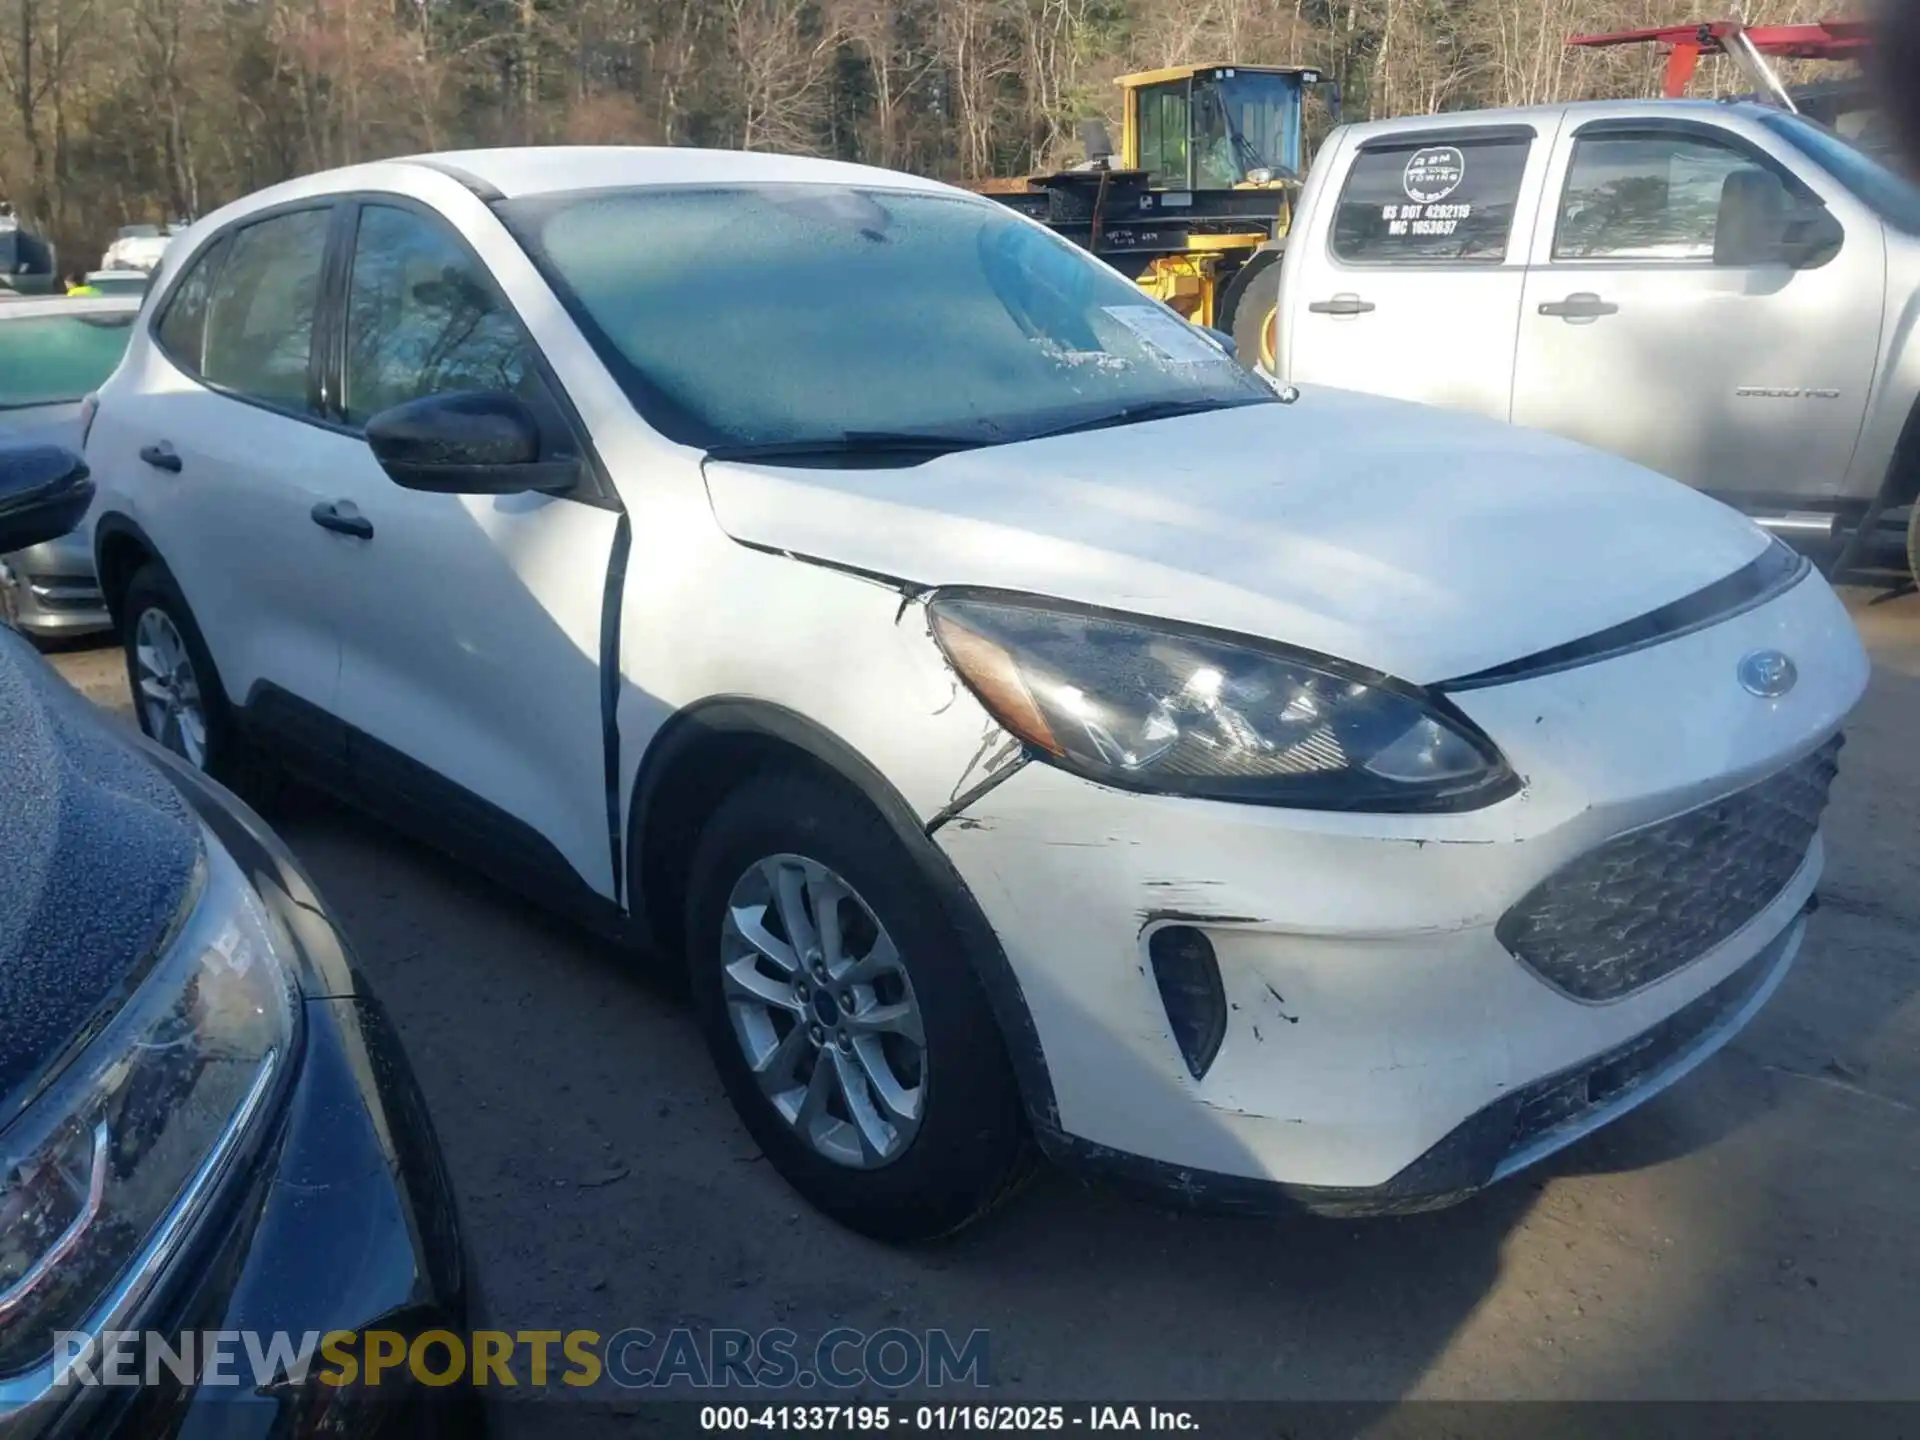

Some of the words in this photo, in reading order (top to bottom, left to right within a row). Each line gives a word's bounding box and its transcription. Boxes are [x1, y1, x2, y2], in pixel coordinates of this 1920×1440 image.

[1409, 174, 1458, 182] TOWING
[1382, 204, 1398, 220] US
[1401, 204, 1423, 219] DOT
[1388, 220, 1408, 235] MC
